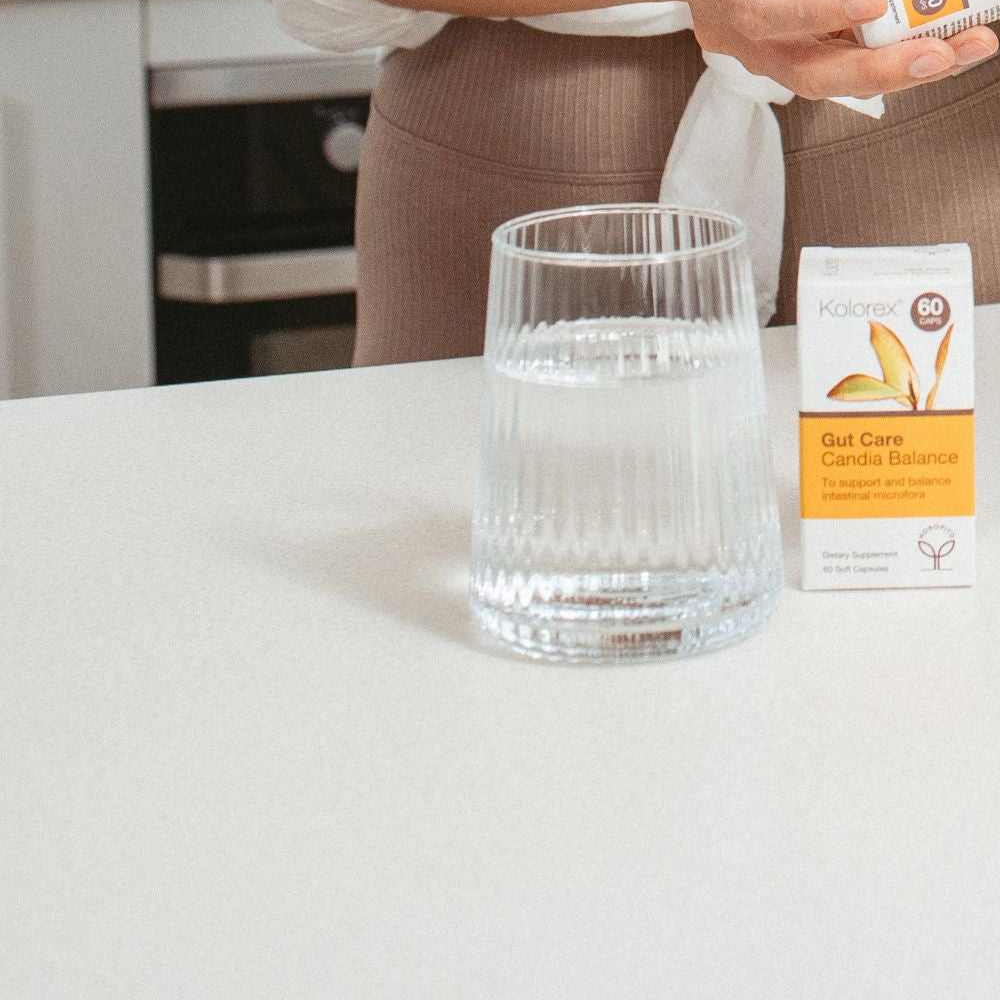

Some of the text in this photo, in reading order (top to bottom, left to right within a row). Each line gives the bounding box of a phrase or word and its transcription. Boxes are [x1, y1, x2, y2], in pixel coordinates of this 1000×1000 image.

[819, 299, 898, 319] Kolorex
[917, 297, 944, 316] 60
[919, 317, 943, 326] CAPS
[821, 432, 904, 448] Gut Care
[821, 450, 959, 467] Candia Balance
[822, 477, 952, 490] To support and balance
[821, 490, 871, 501] intestinal
[822, 551, 898, 560] Dietary Supplement
[853, 564, 889, 575] Capsules
